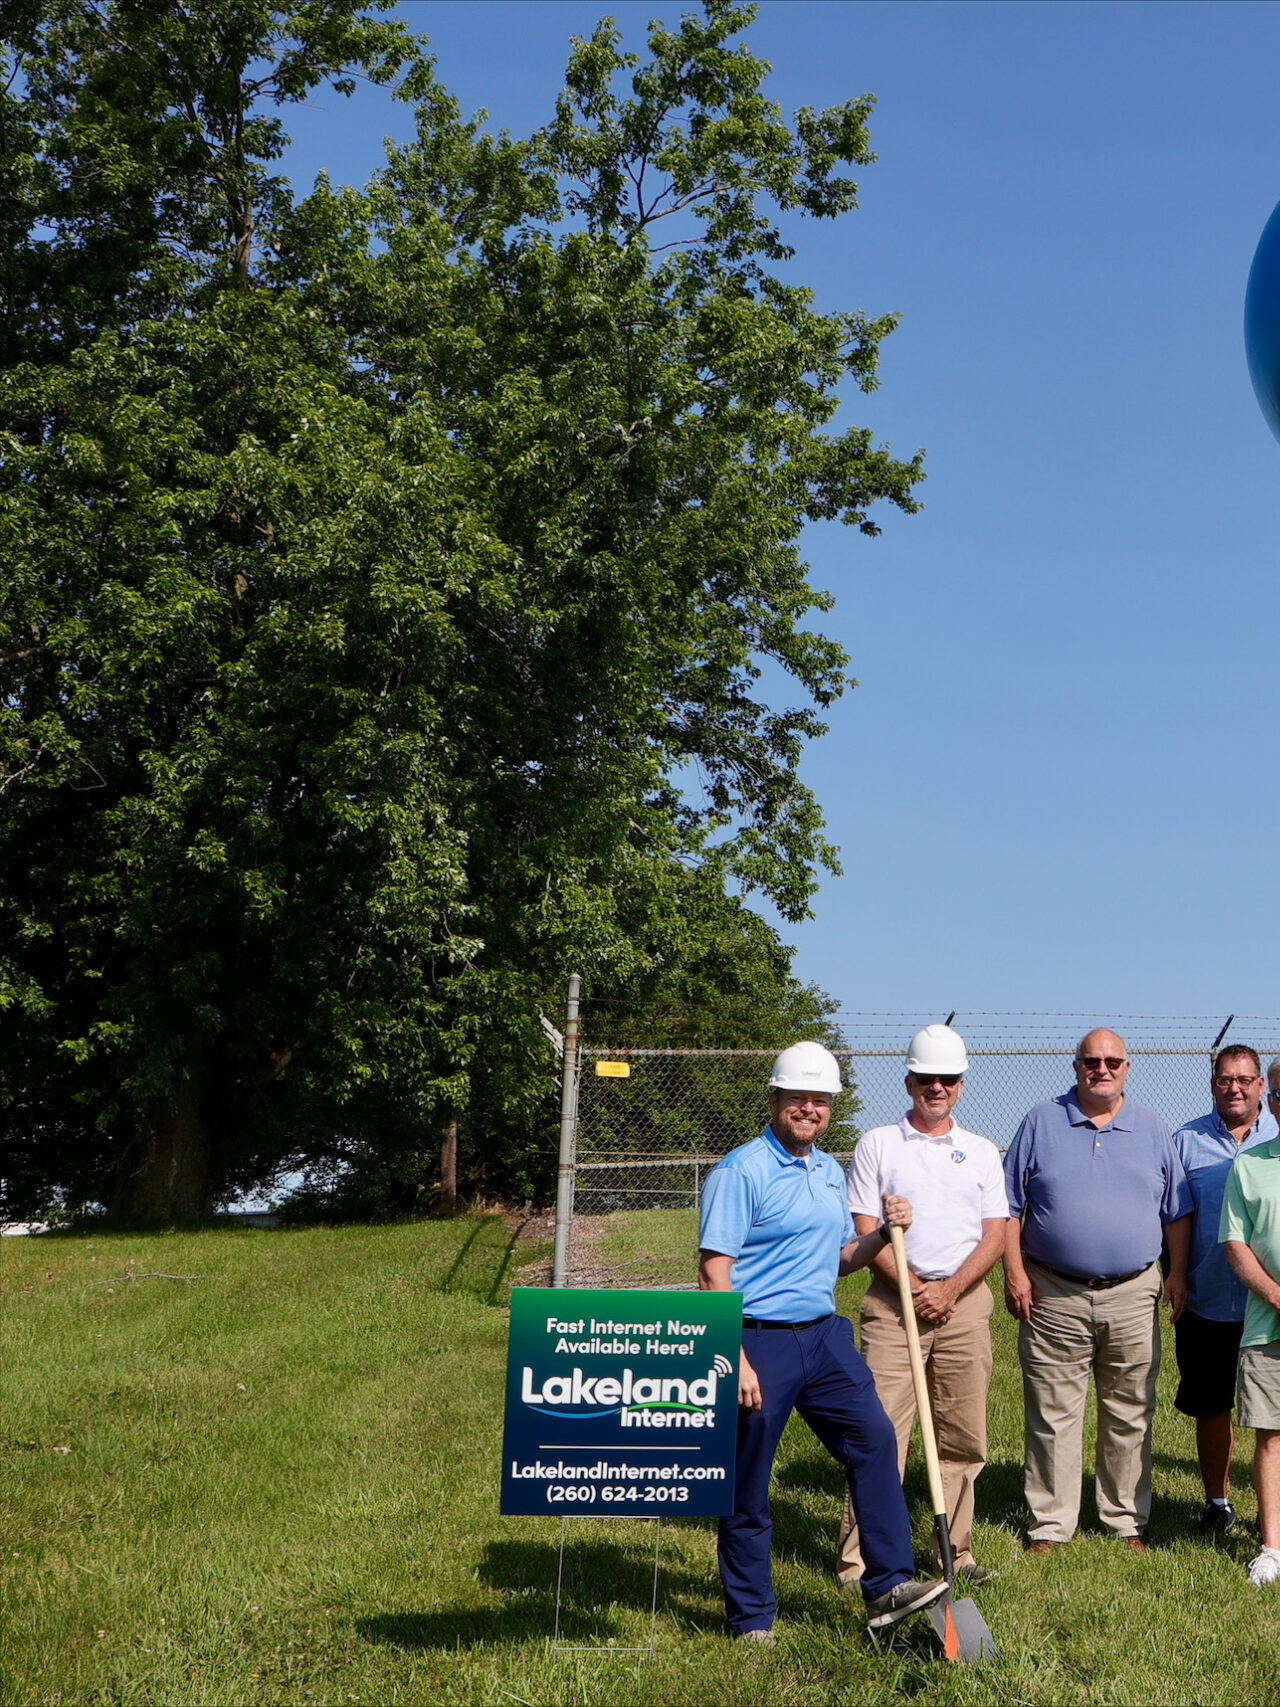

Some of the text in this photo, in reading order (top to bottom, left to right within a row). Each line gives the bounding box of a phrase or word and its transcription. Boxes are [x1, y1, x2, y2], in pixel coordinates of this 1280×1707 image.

[546, 1317, 707, 1336] Fast Internet Now
[554, 1338, 695, 1355] Available Here!
[521, 1366, 718, 1406] Lakeland
[620, 1406, 715, 1428] Internet
[511, 1461, 726, 1480] LakelandInternet.com
[546, 1485, 689, 1503] (260) 624-2013
